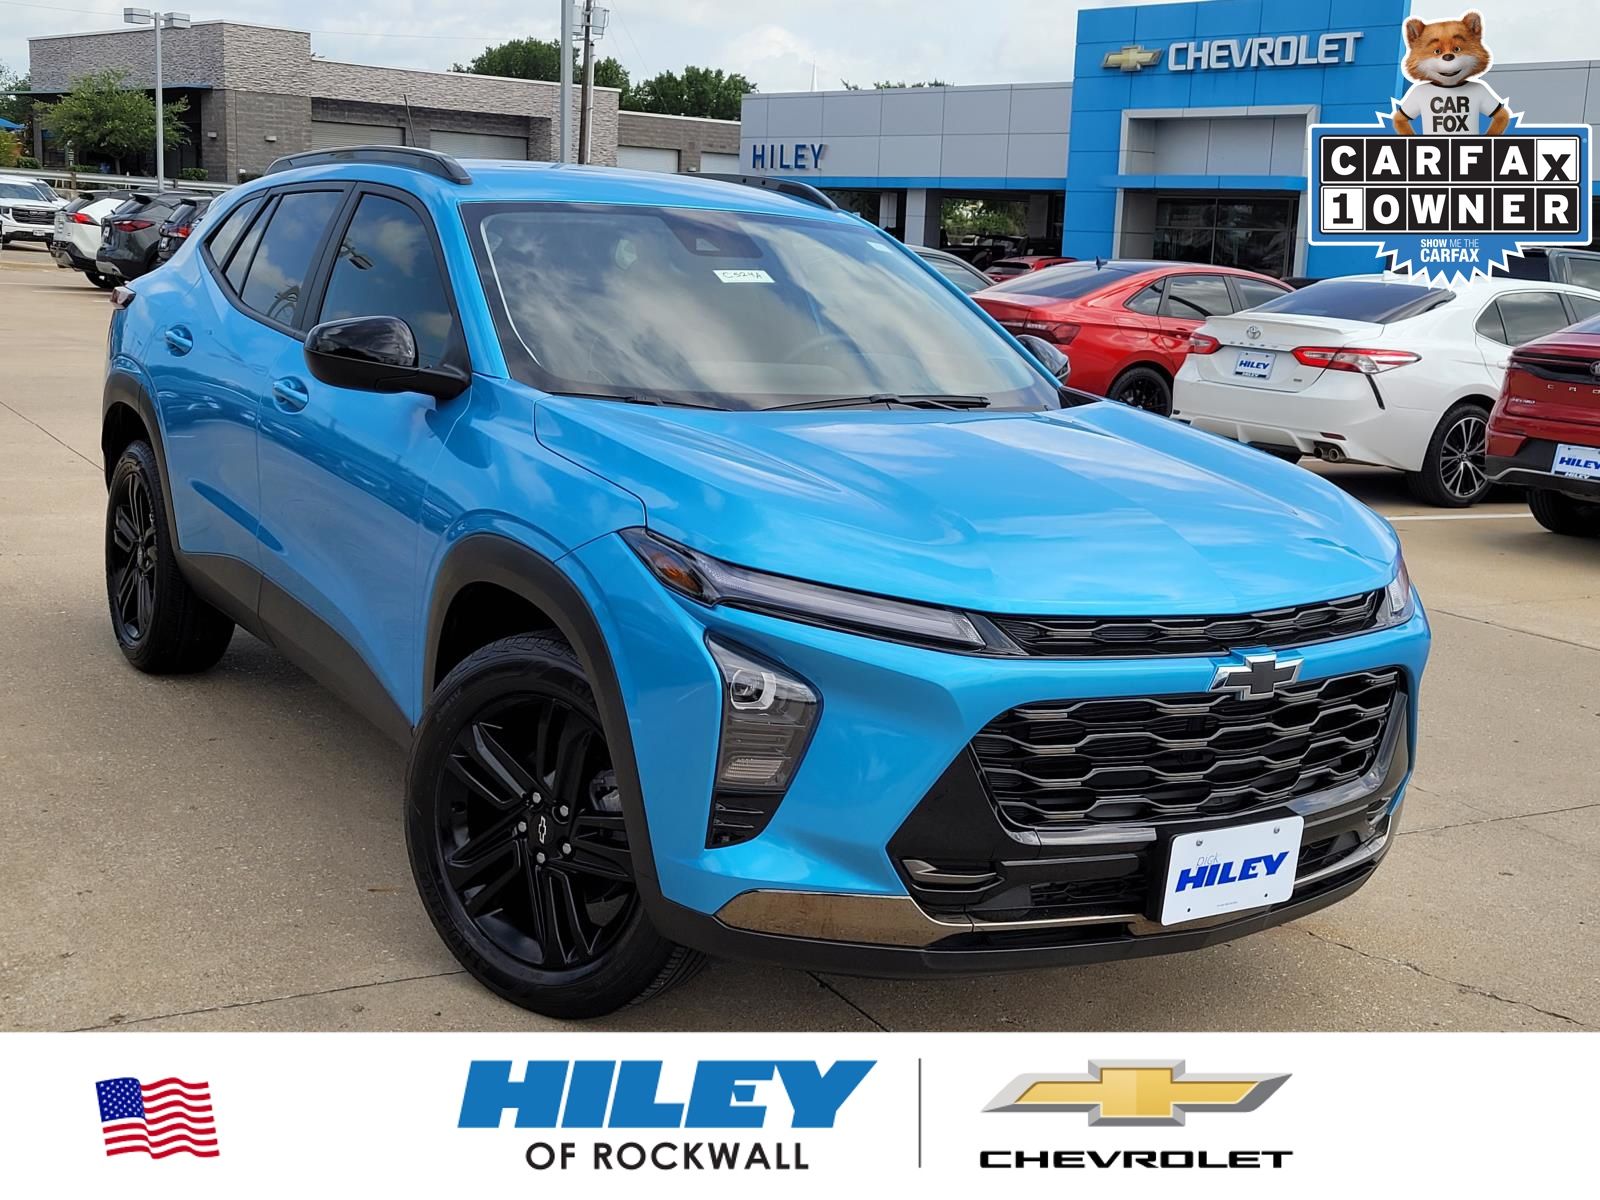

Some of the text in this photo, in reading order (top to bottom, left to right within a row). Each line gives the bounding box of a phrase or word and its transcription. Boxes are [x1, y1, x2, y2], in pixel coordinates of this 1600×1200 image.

[1168, 31, 1364, 71] CHEVROLET
[752, 144, 824, 169] HILEY
[1238, 360, 1270, 370] HILEY
[1175, 851, 1290, 893] HILEY
